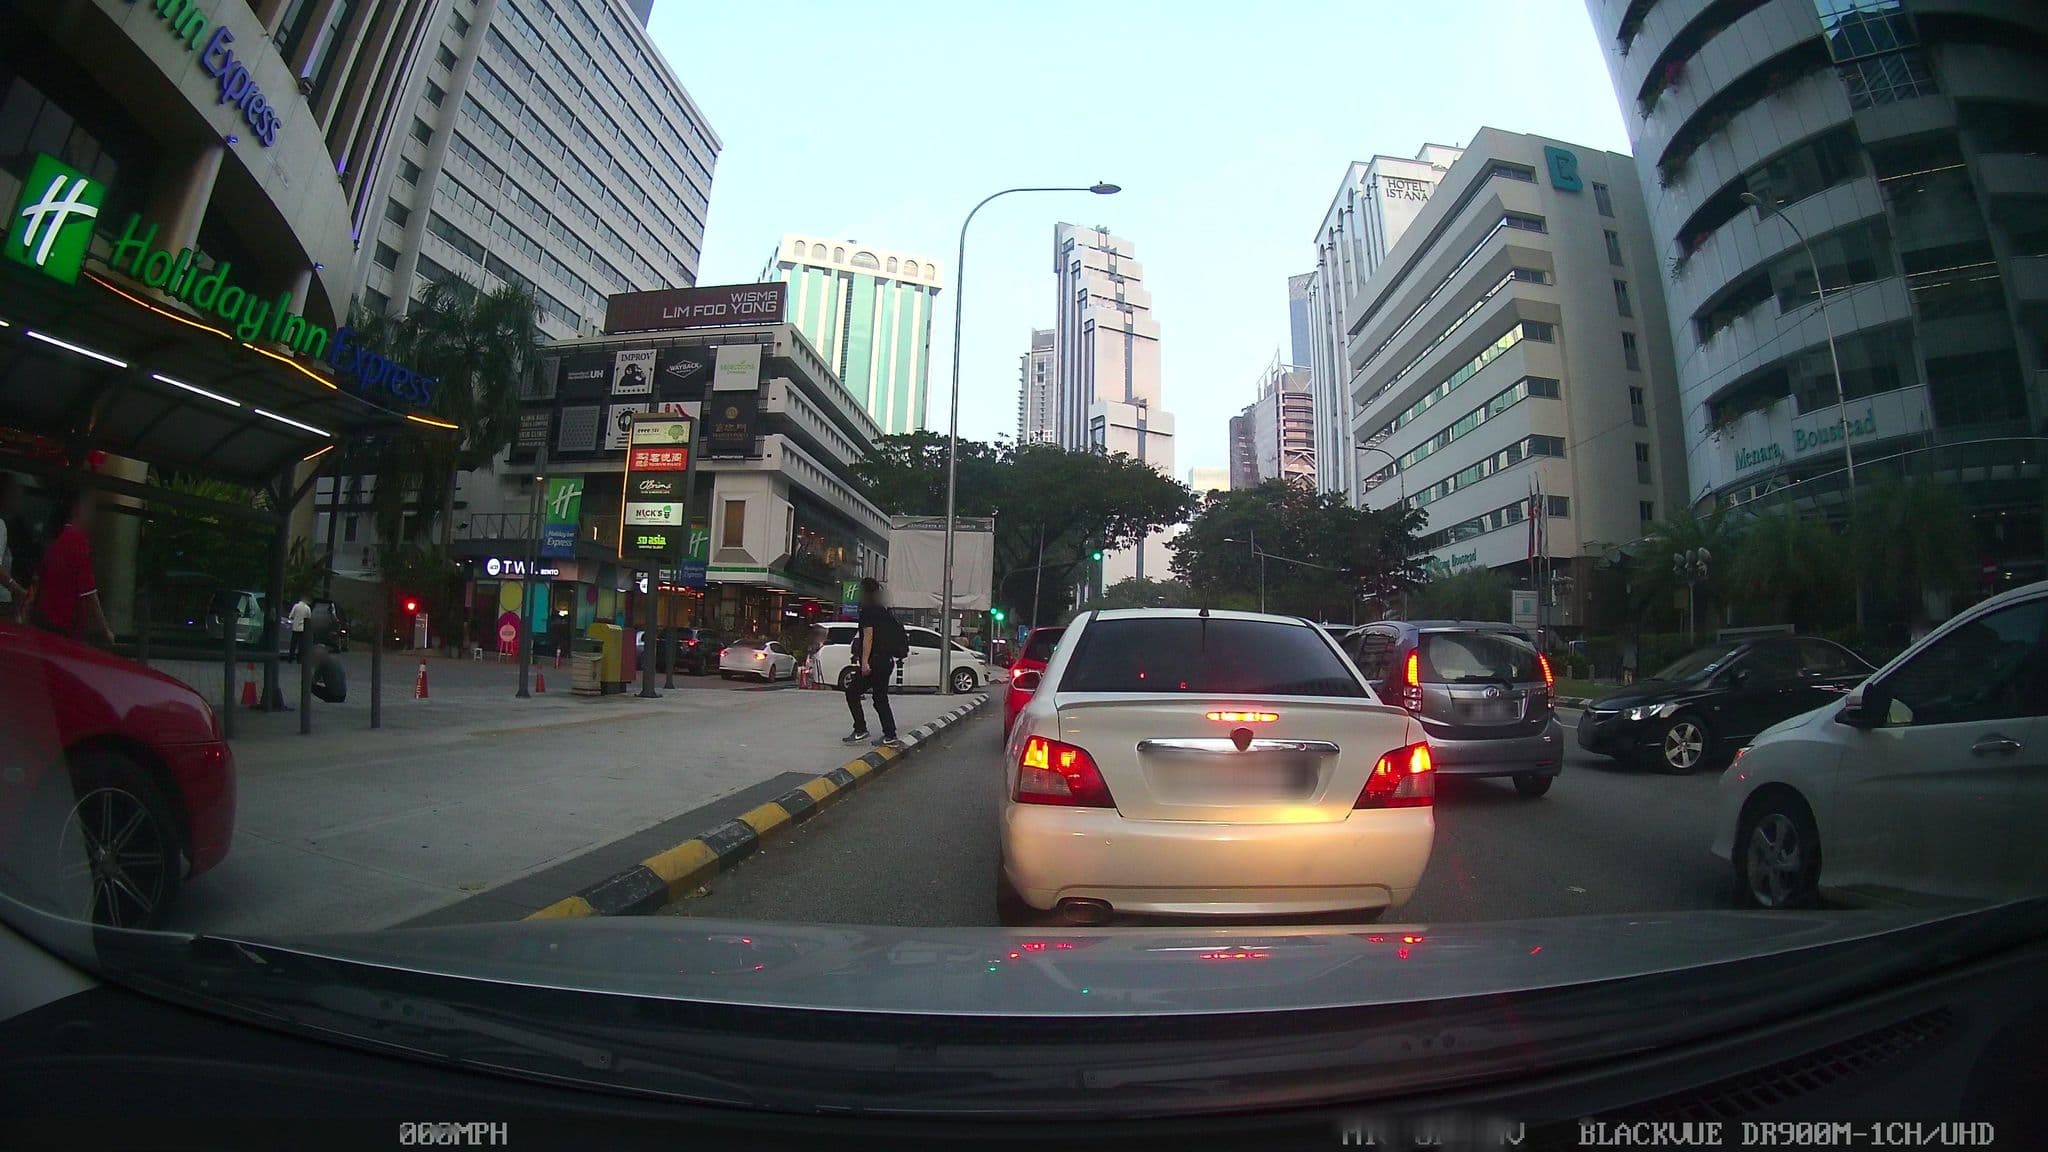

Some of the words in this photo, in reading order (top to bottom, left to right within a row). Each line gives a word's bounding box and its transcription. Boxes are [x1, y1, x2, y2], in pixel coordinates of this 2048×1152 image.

[201, 26, 281, 147] Express
[1387, 178, 1426, 192] HOTEL
[1386, 188, 1429, 202] ISTANA
[731, 290, 778, 303] WISMA
[112, 213, 268, 342] Holiday
[267, 292, 328, 359] Inn
[328, 325, 435, 405] Express
[663, 306, 690, 319] LIM
[693, 303, 727, 317] FOO
[730, 301, 777, 314] YONG
[620, 352, 652, 361] IMPROV
[669, 362, 699, 371] WAYBACK
[590, 369, 604, 379] UH
[1735, 440, 1786, 472] Menara
[1794, 407, 1877, 451] Boustead
